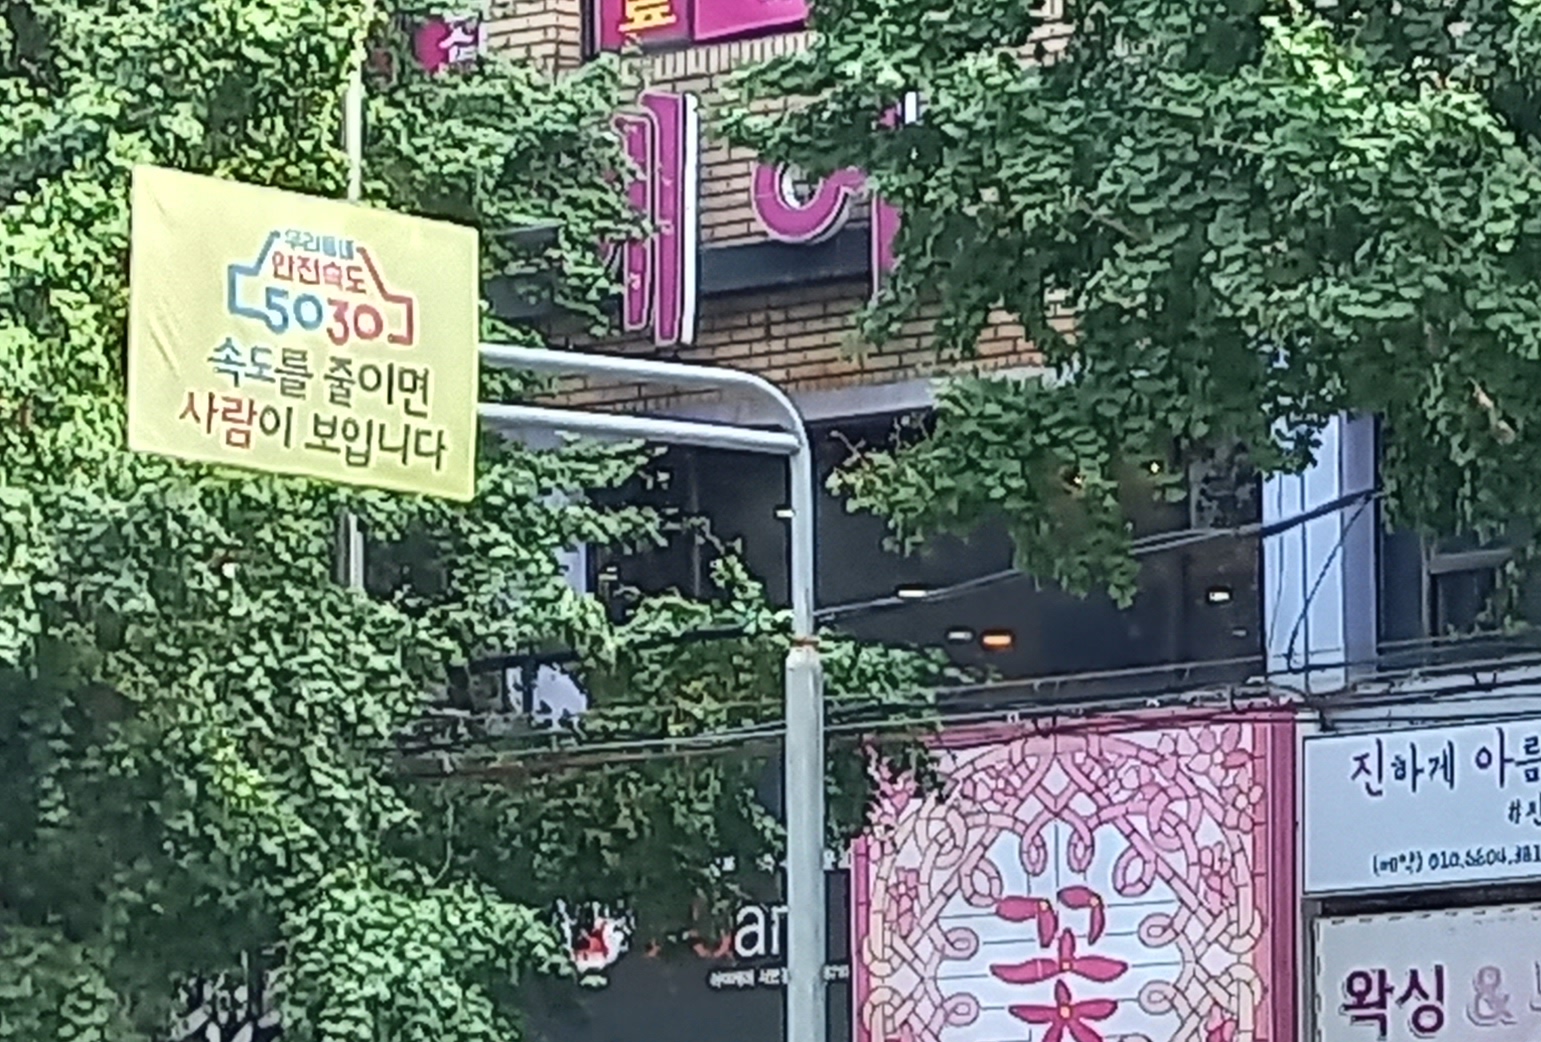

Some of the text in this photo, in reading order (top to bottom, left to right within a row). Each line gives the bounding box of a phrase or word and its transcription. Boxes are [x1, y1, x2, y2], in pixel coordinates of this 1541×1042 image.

[207, 336, 430, 418] 속도를 줄이면
[179, 390, 448, 472] 사람이 보입니다
[1351, 737, 1455, 798] 진하게
[1342, 962, 1449, 1041] 왁싱
